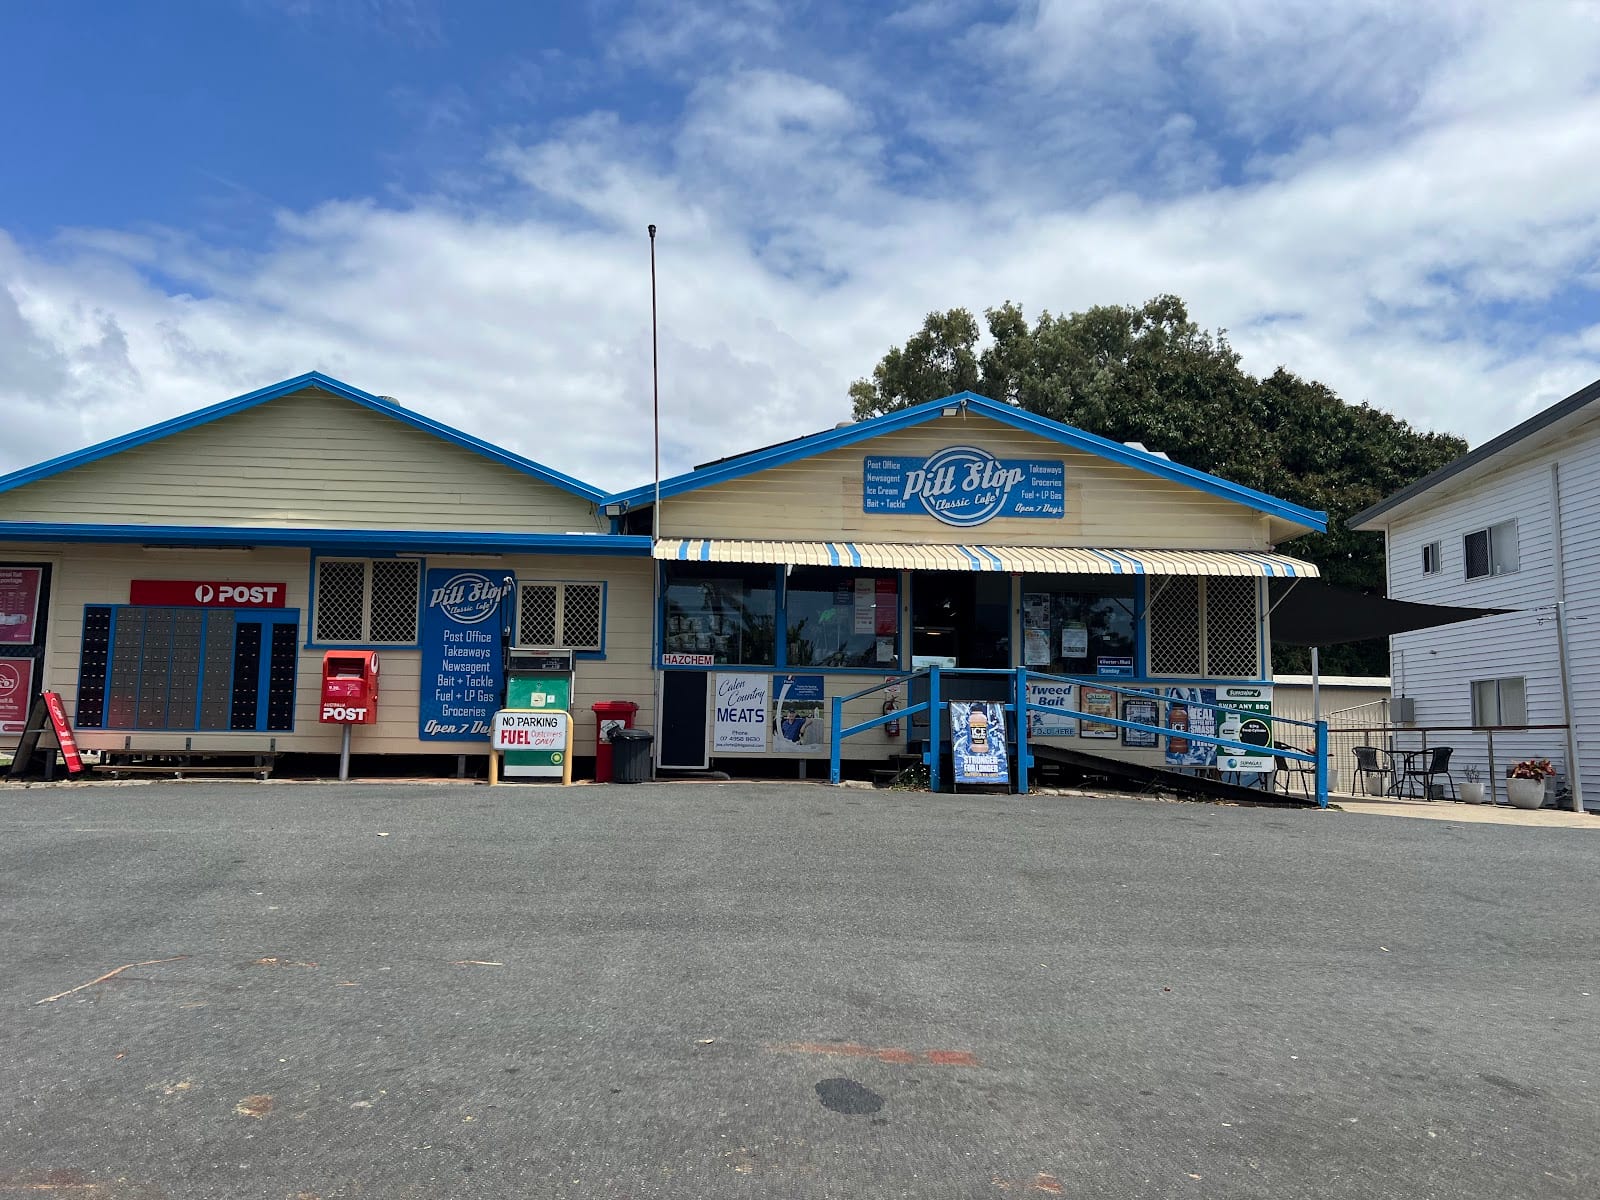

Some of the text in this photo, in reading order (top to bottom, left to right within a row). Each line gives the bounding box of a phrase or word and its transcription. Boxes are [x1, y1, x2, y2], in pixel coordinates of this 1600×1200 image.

[867, 460, 900, 470] Post Office
[1029, 464, 1062, 475] Takeaways
[867, 473, 900, 483] Newsagent
[903, 461, 1025, 500] Pitt Stop
[1031, 478, 1062, 487] Groceries
[867, 486, 898, 496] Ice Cream
[1021, 490, 1034, 499] Fuel
[1041, 491, 1049, 499] LP
[1050, 491, 1062, 500] Gas
[866, 499, 879, 508] Bait
[886, 499, 905, 509] Tackle
[936, 498, 970, 510] Classic
[1014, 504, 1034, 514] Open
[1042, 504, 1064, 514] Days
[219, 586, 277, 603] POST
[430, 582, 507, 607] Pitt Stop
[450, 605, 474, 614] Classic
[443, 630, 491, 643] Post Office
[443, 644, 490, 659] Takeaways
[664, 655, 712, 665] HAZCHEM
[442, 659, 490, 674] Newsagent
[437, 674, 455, 686] Bait
[465, 674, 494, 687] Tackle
[435, 689, 453, 701] Fuel
[464, 690, 475, 701] LP
[477, 690, 494, 702] Gas
[1031, 685, 1072, 695] Tweed
[728, 687, 765, 707] Country
[1038, 697, 1065, 706] Bait
[322, 708, 367, 720] POST
[442, 704, 486, 717] Groceries
[717, 708, 764, 723] MEATS
[1188, 706, 1214, 720] REAL
[424, 719, 457, 736] Open
[459, 723, 469, 733] 7
[502, 716, 558, 728] NO PARKING
[1171, 723, 1186, 731] ICE
[1190, 725, 1215, 734] SMASH
[501, 729, 530, 744] FUEL
[964, 756, 999, 764] STRONGER
[964, 764, 999, 772] FOR LONGER
